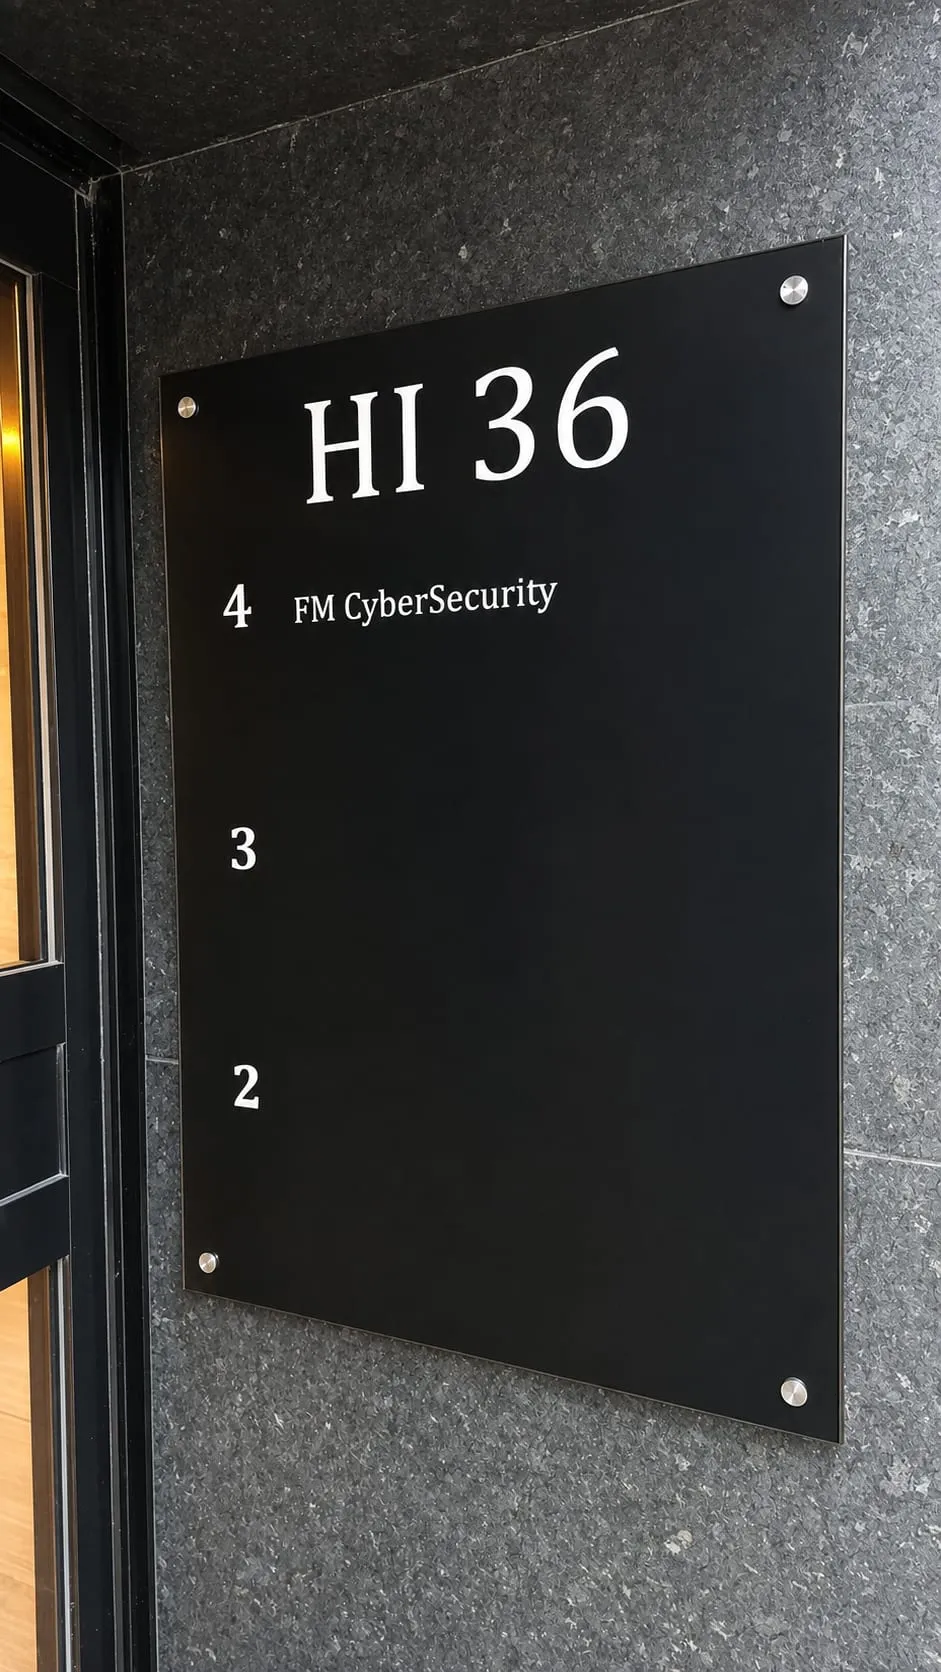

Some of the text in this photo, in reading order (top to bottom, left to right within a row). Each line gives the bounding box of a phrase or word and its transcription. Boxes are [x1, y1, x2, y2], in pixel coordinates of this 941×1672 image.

[303, 346, 629, 505] HI 36
[222, 577, 559, 629] 4 FM CyberSecurity
[231, 826, 258, 871] 3
[233, 1064, 260, 1110] 2
